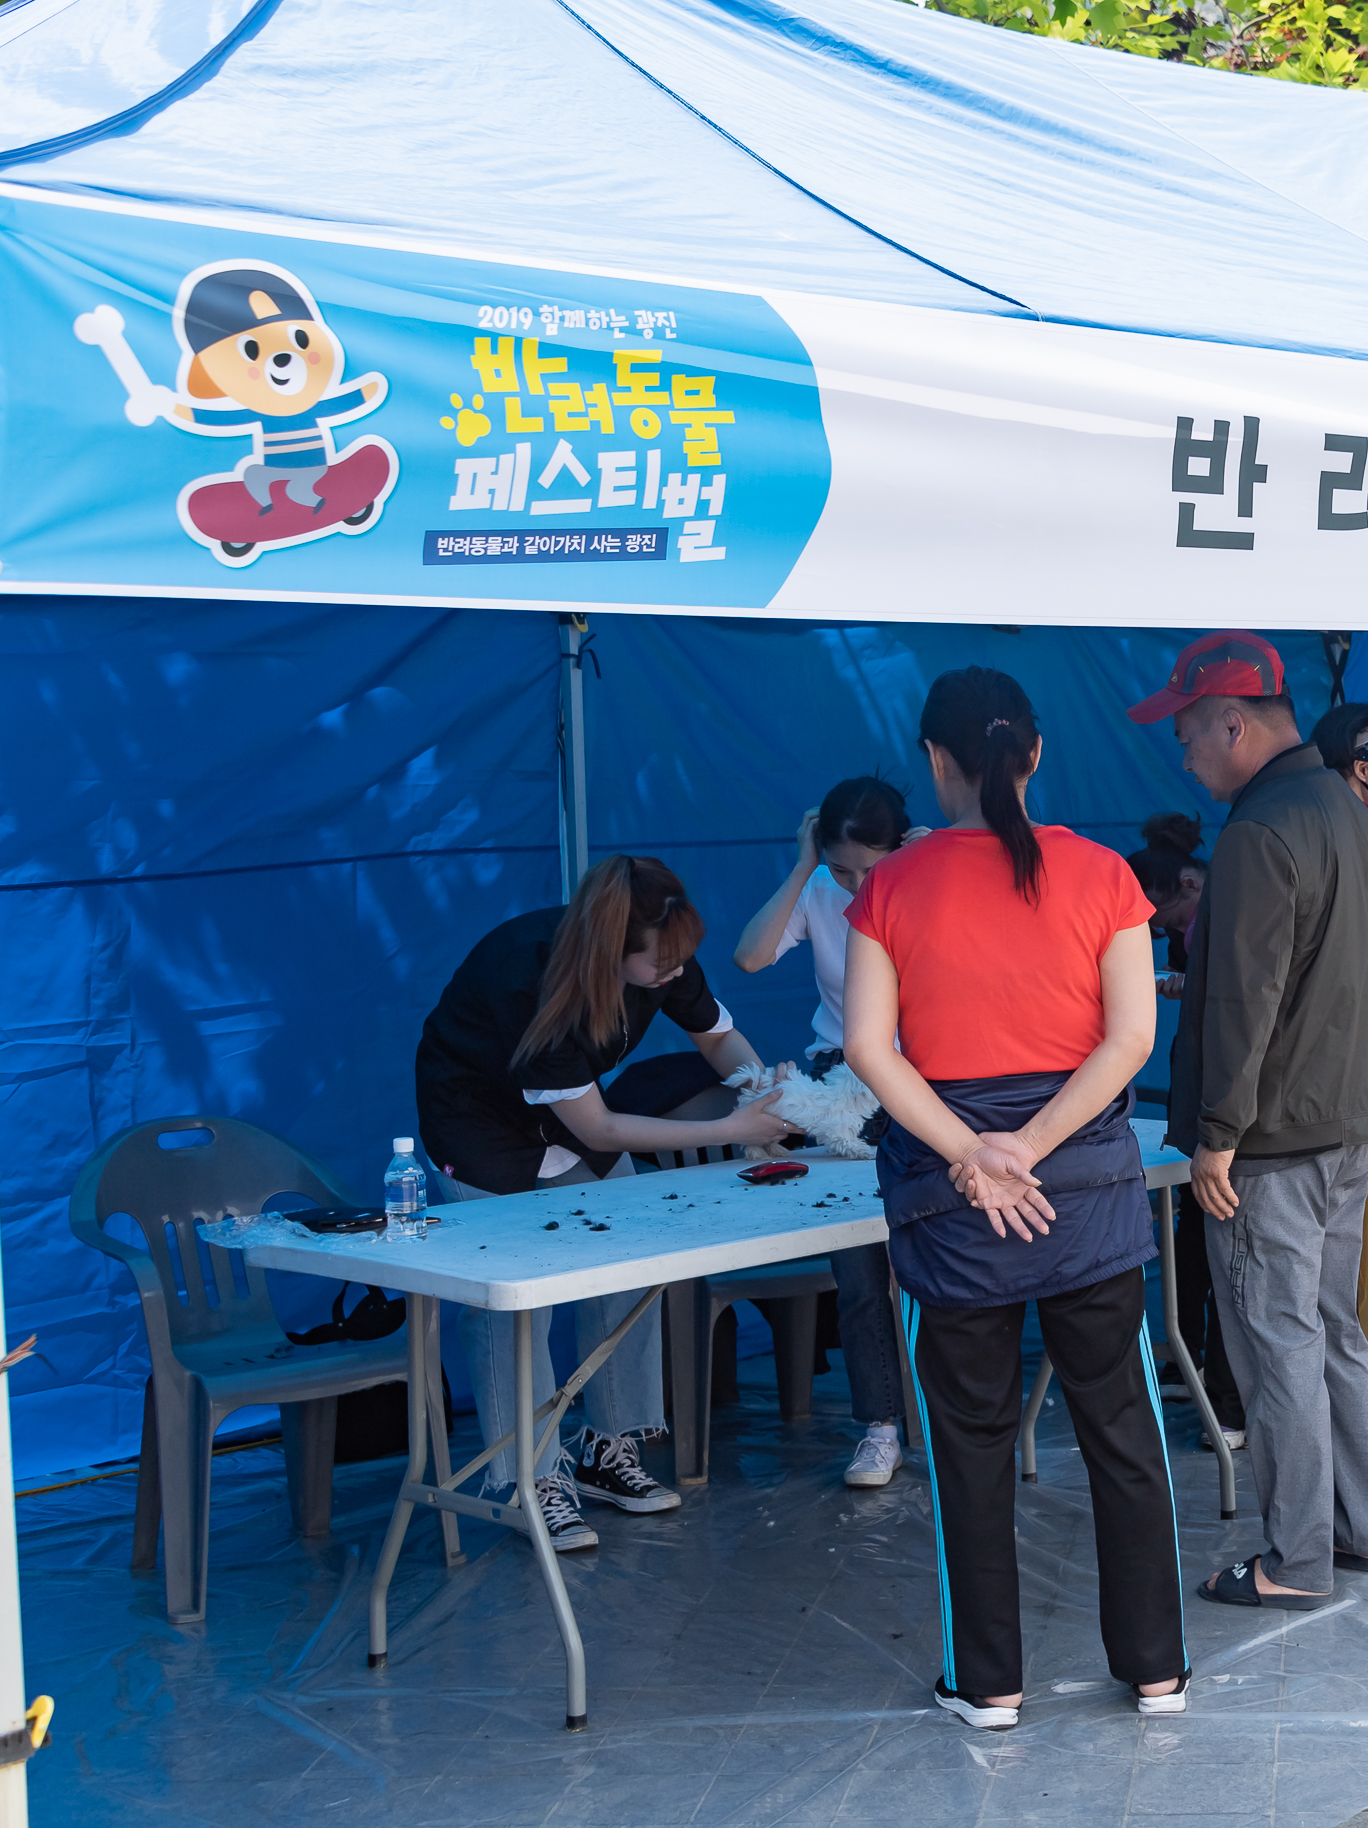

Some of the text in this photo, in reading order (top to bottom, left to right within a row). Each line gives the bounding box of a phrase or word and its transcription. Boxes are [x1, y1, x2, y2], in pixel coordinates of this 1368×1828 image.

[477, 304, 678, 340] 2019 함께하는 광진
[470, 336, 736, 467] 반려동물
[448, 437, 727, 563] 페스티벌
[437, 533, 658, 557] 반려동물과 같이가치 사는 광진
